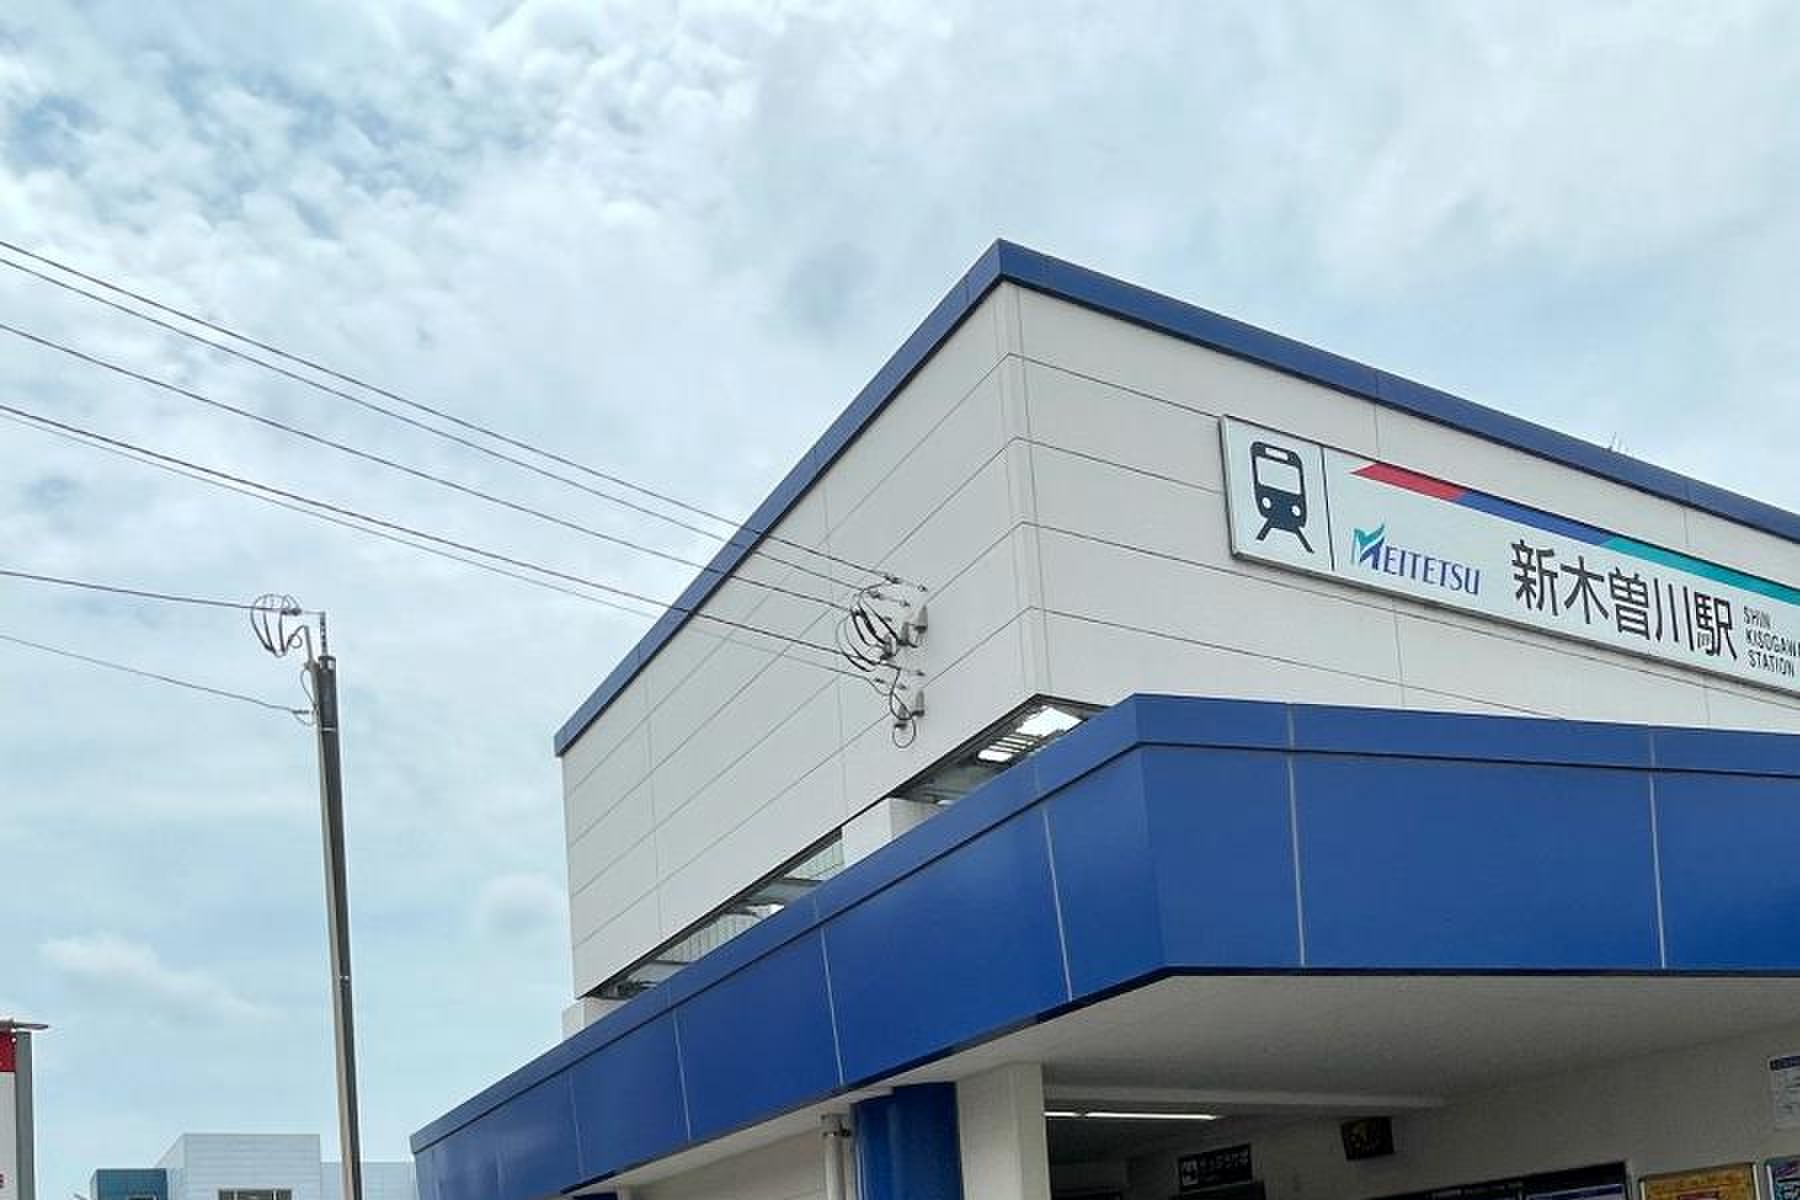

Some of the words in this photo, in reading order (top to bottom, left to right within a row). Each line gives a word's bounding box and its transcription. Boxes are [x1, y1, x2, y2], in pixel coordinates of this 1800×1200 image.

[1351, 523, 1481, 596] MEITETSU
[1511, 539, 1738, 660] 新木曽川駅
[1744, 606, 1771, 629] SHIN
[1747, 649, 1795, 677] STATION
